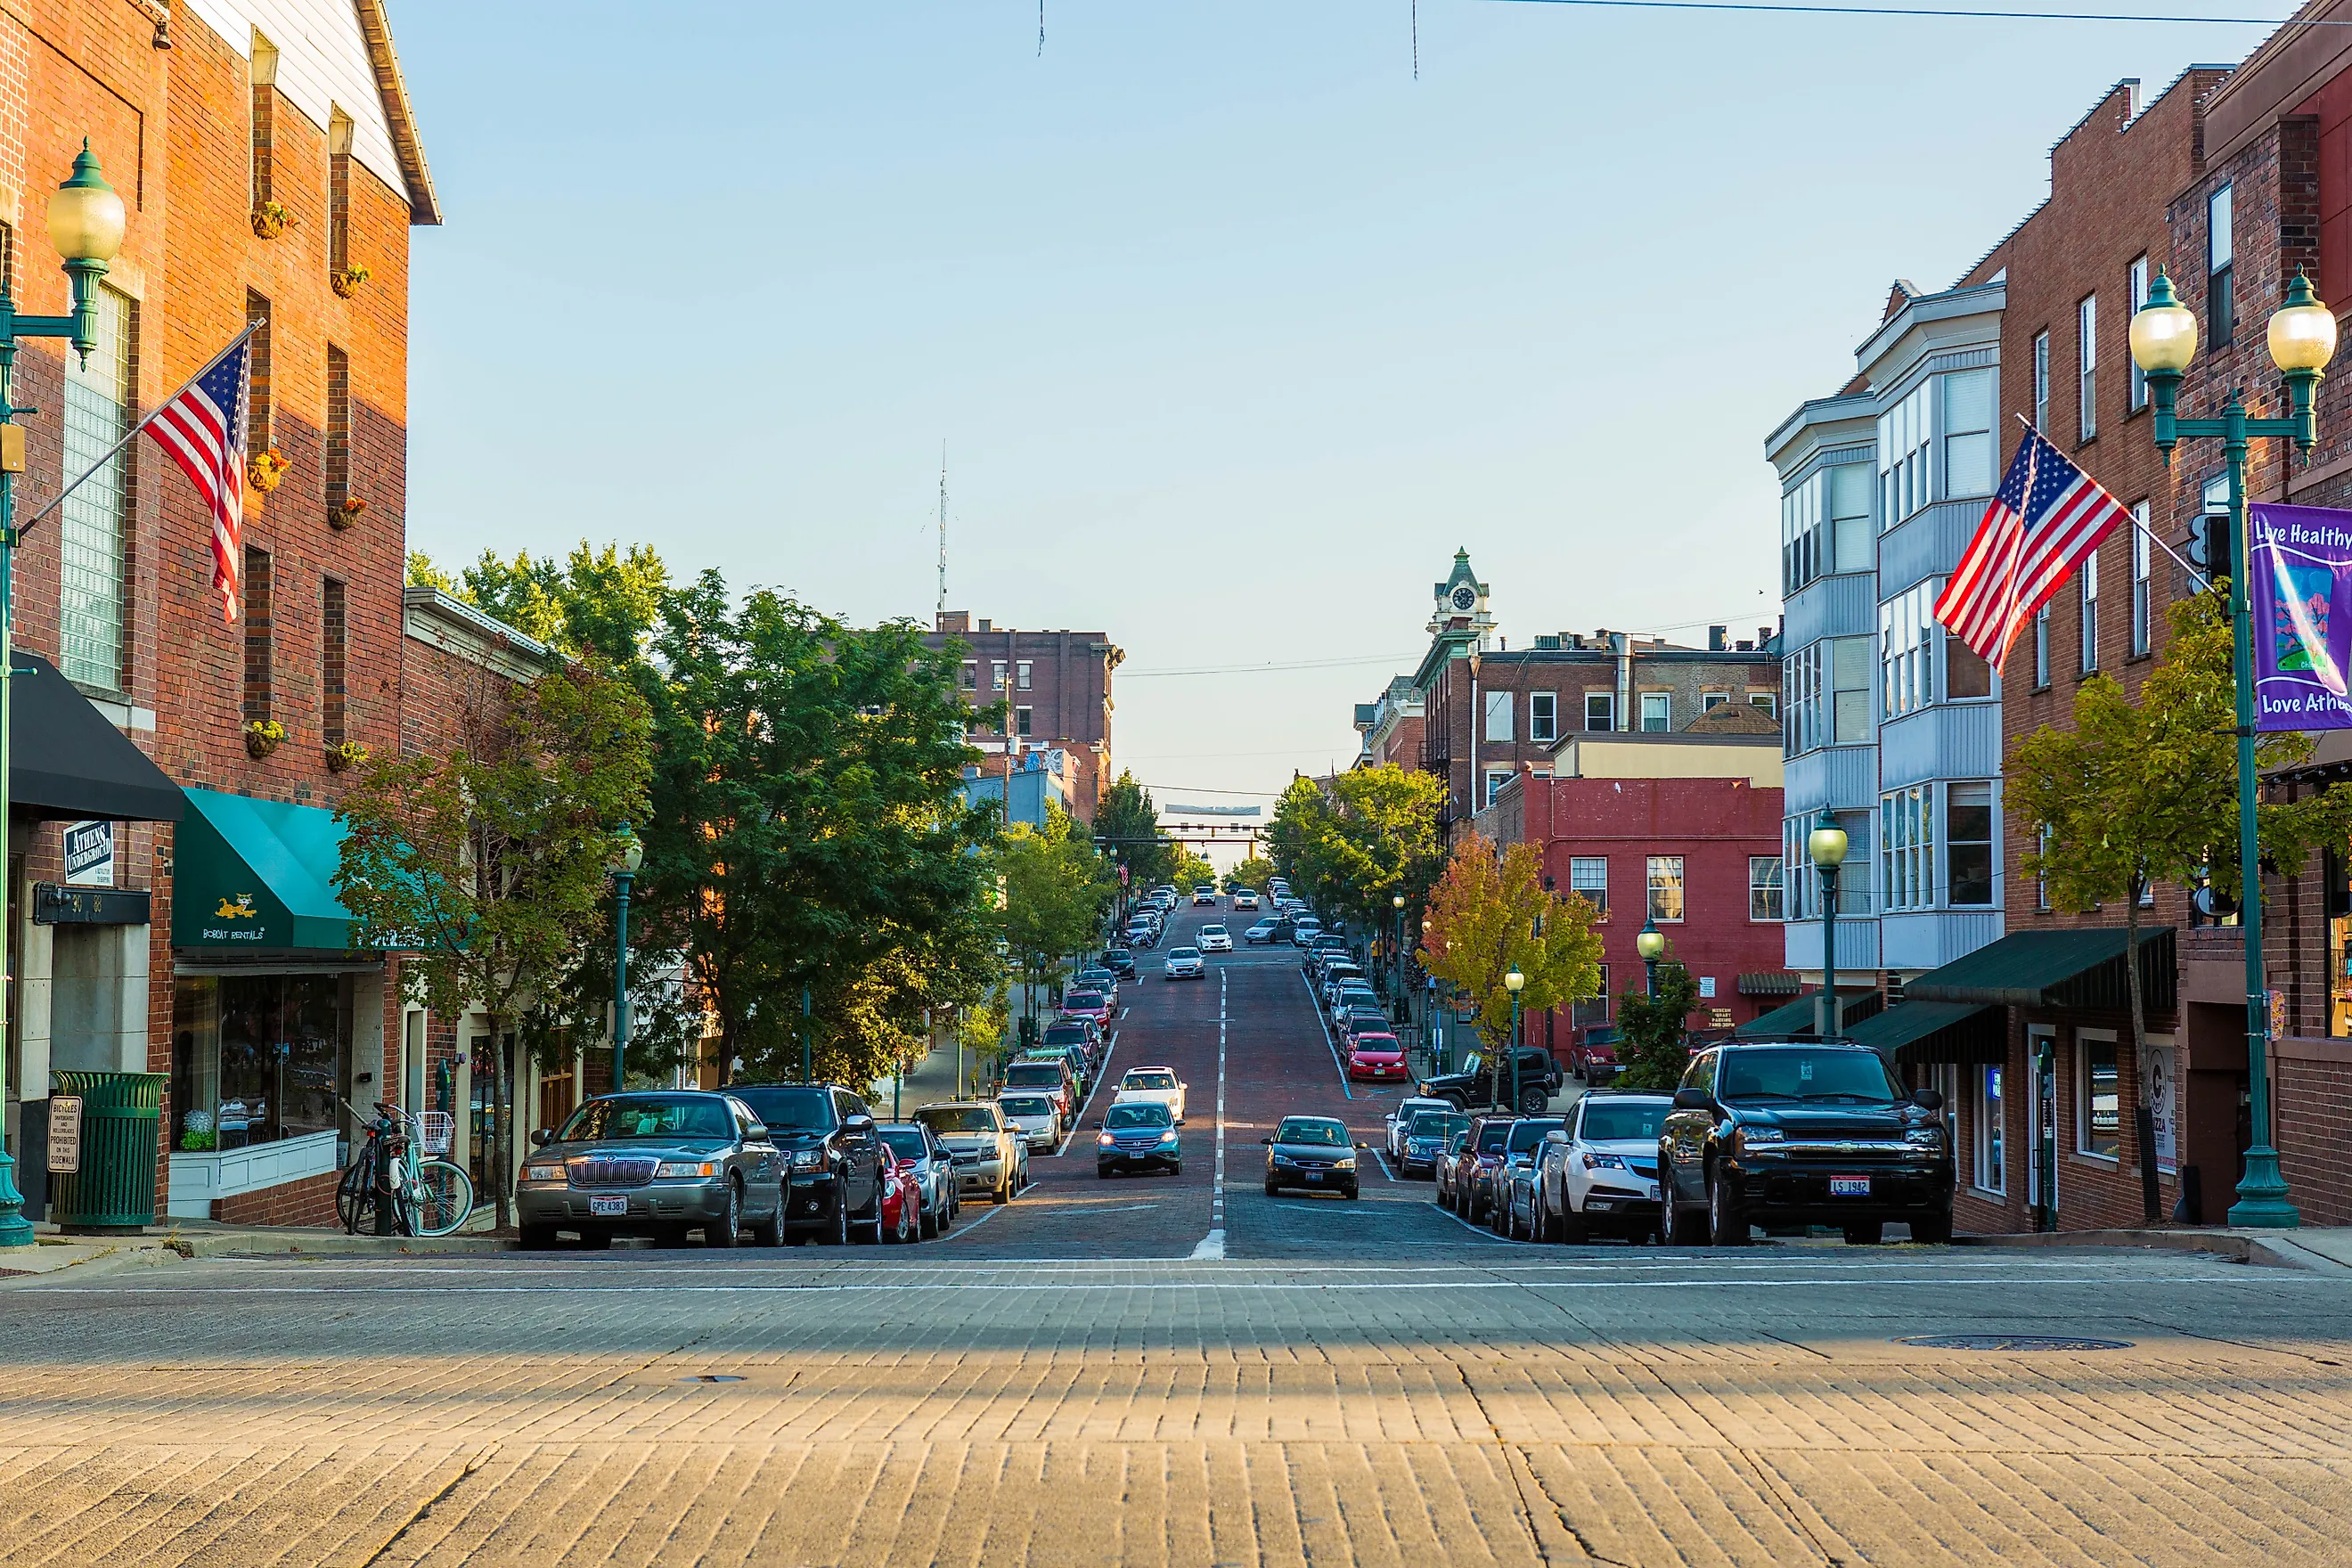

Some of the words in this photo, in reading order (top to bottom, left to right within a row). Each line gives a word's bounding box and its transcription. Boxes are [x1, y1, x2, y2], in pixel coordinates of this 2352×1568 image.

[2255, 520, 2286, 542] Live
[2291, 523, 2352, 551] Healthy
[2262, 694, 2301, 714] Love
[73, 824, 106, 855] ATHENS
[67, 837, 110, 871] UNDERGROUND
[203, 928, 228, 940] BOBCAT
[231, 929, 264, 941] RENTALS
[53, 1104, 78, 1114] BICYCLES
[50, 1135, 77, 1146] PROHIBITED
[50, 1155, 75, 1164] SIDEWALK
[1833, 1181, 1843, 1192] LS
[1848, 1181, 1866, 1192] 1942
[592, 1201, 606, 1212] GPE
[607, 1201, 625, 1211] 4383
